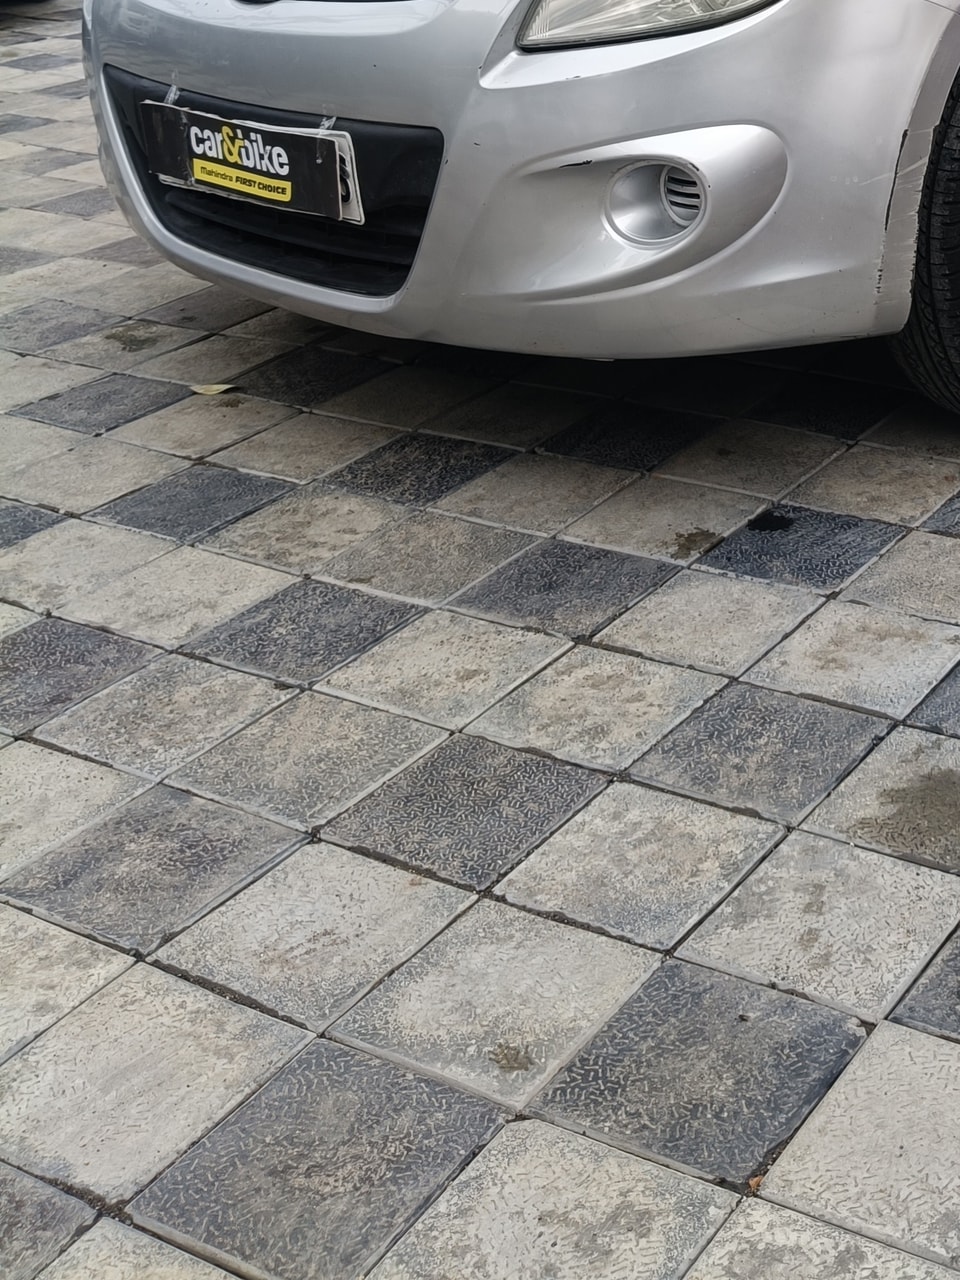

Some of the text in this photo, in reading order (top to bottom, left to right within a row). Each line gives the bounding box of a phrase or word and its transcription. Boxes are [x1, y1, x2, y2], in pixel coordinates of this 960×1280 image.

[190, 125, 290, 176] car&bike
[200, 166, 287, 196] Mahindra FIRST CHOICE
